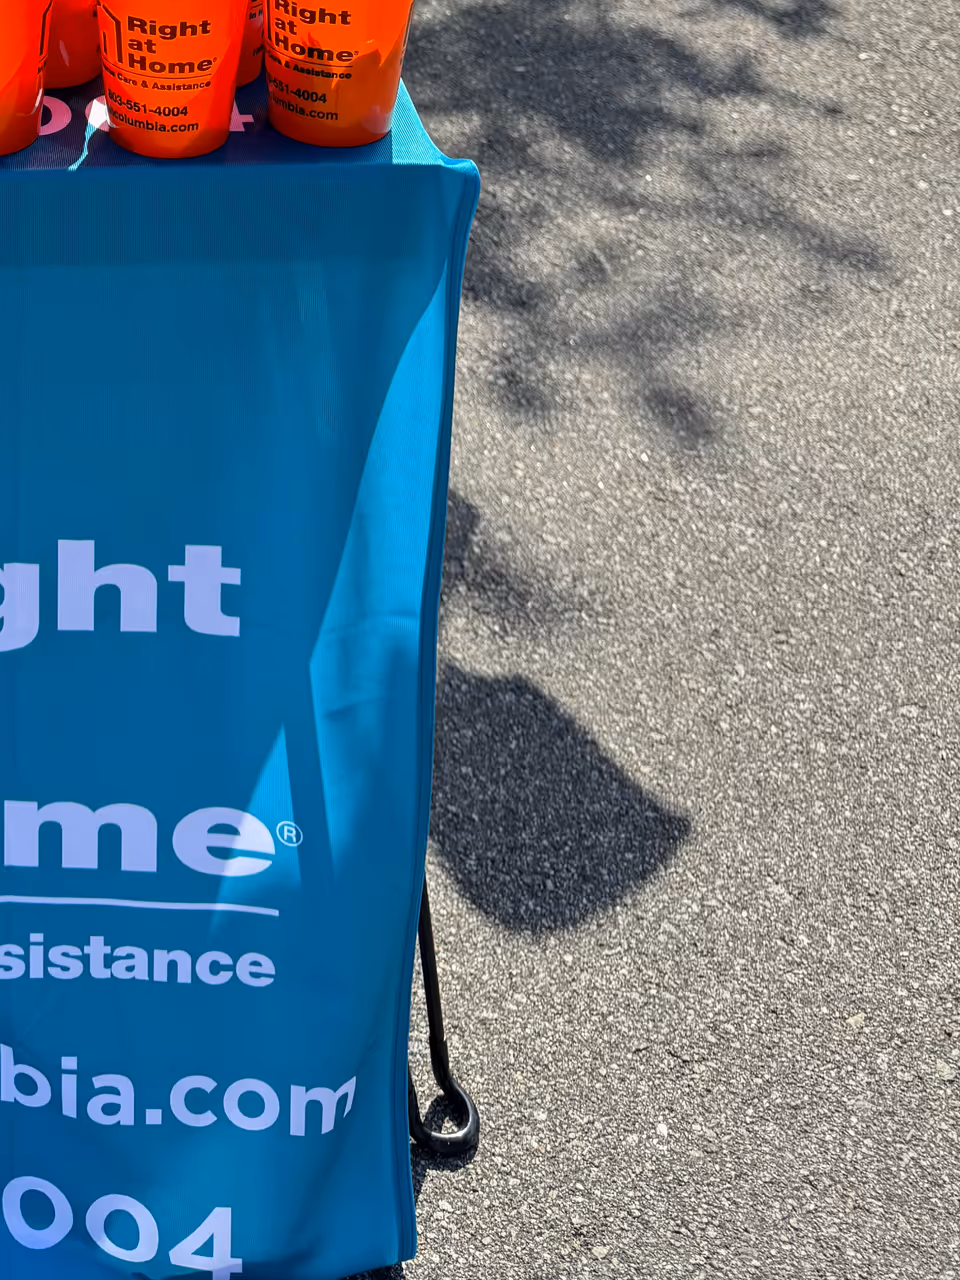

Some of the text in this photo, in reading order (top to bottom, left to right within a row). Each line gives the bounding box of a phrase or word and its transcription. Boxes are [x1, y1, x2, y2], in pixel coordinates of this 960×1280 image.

[128, 16, 211, 40] Right
[275, 17, 297, 36] at
[128, 38, 156, 54] at
[293, 63, 352, 79] Assistance
[117, 73, 137, 86] Care
[141, 80, 148, 89] &
[152, 81, 211, 91] Assistance
